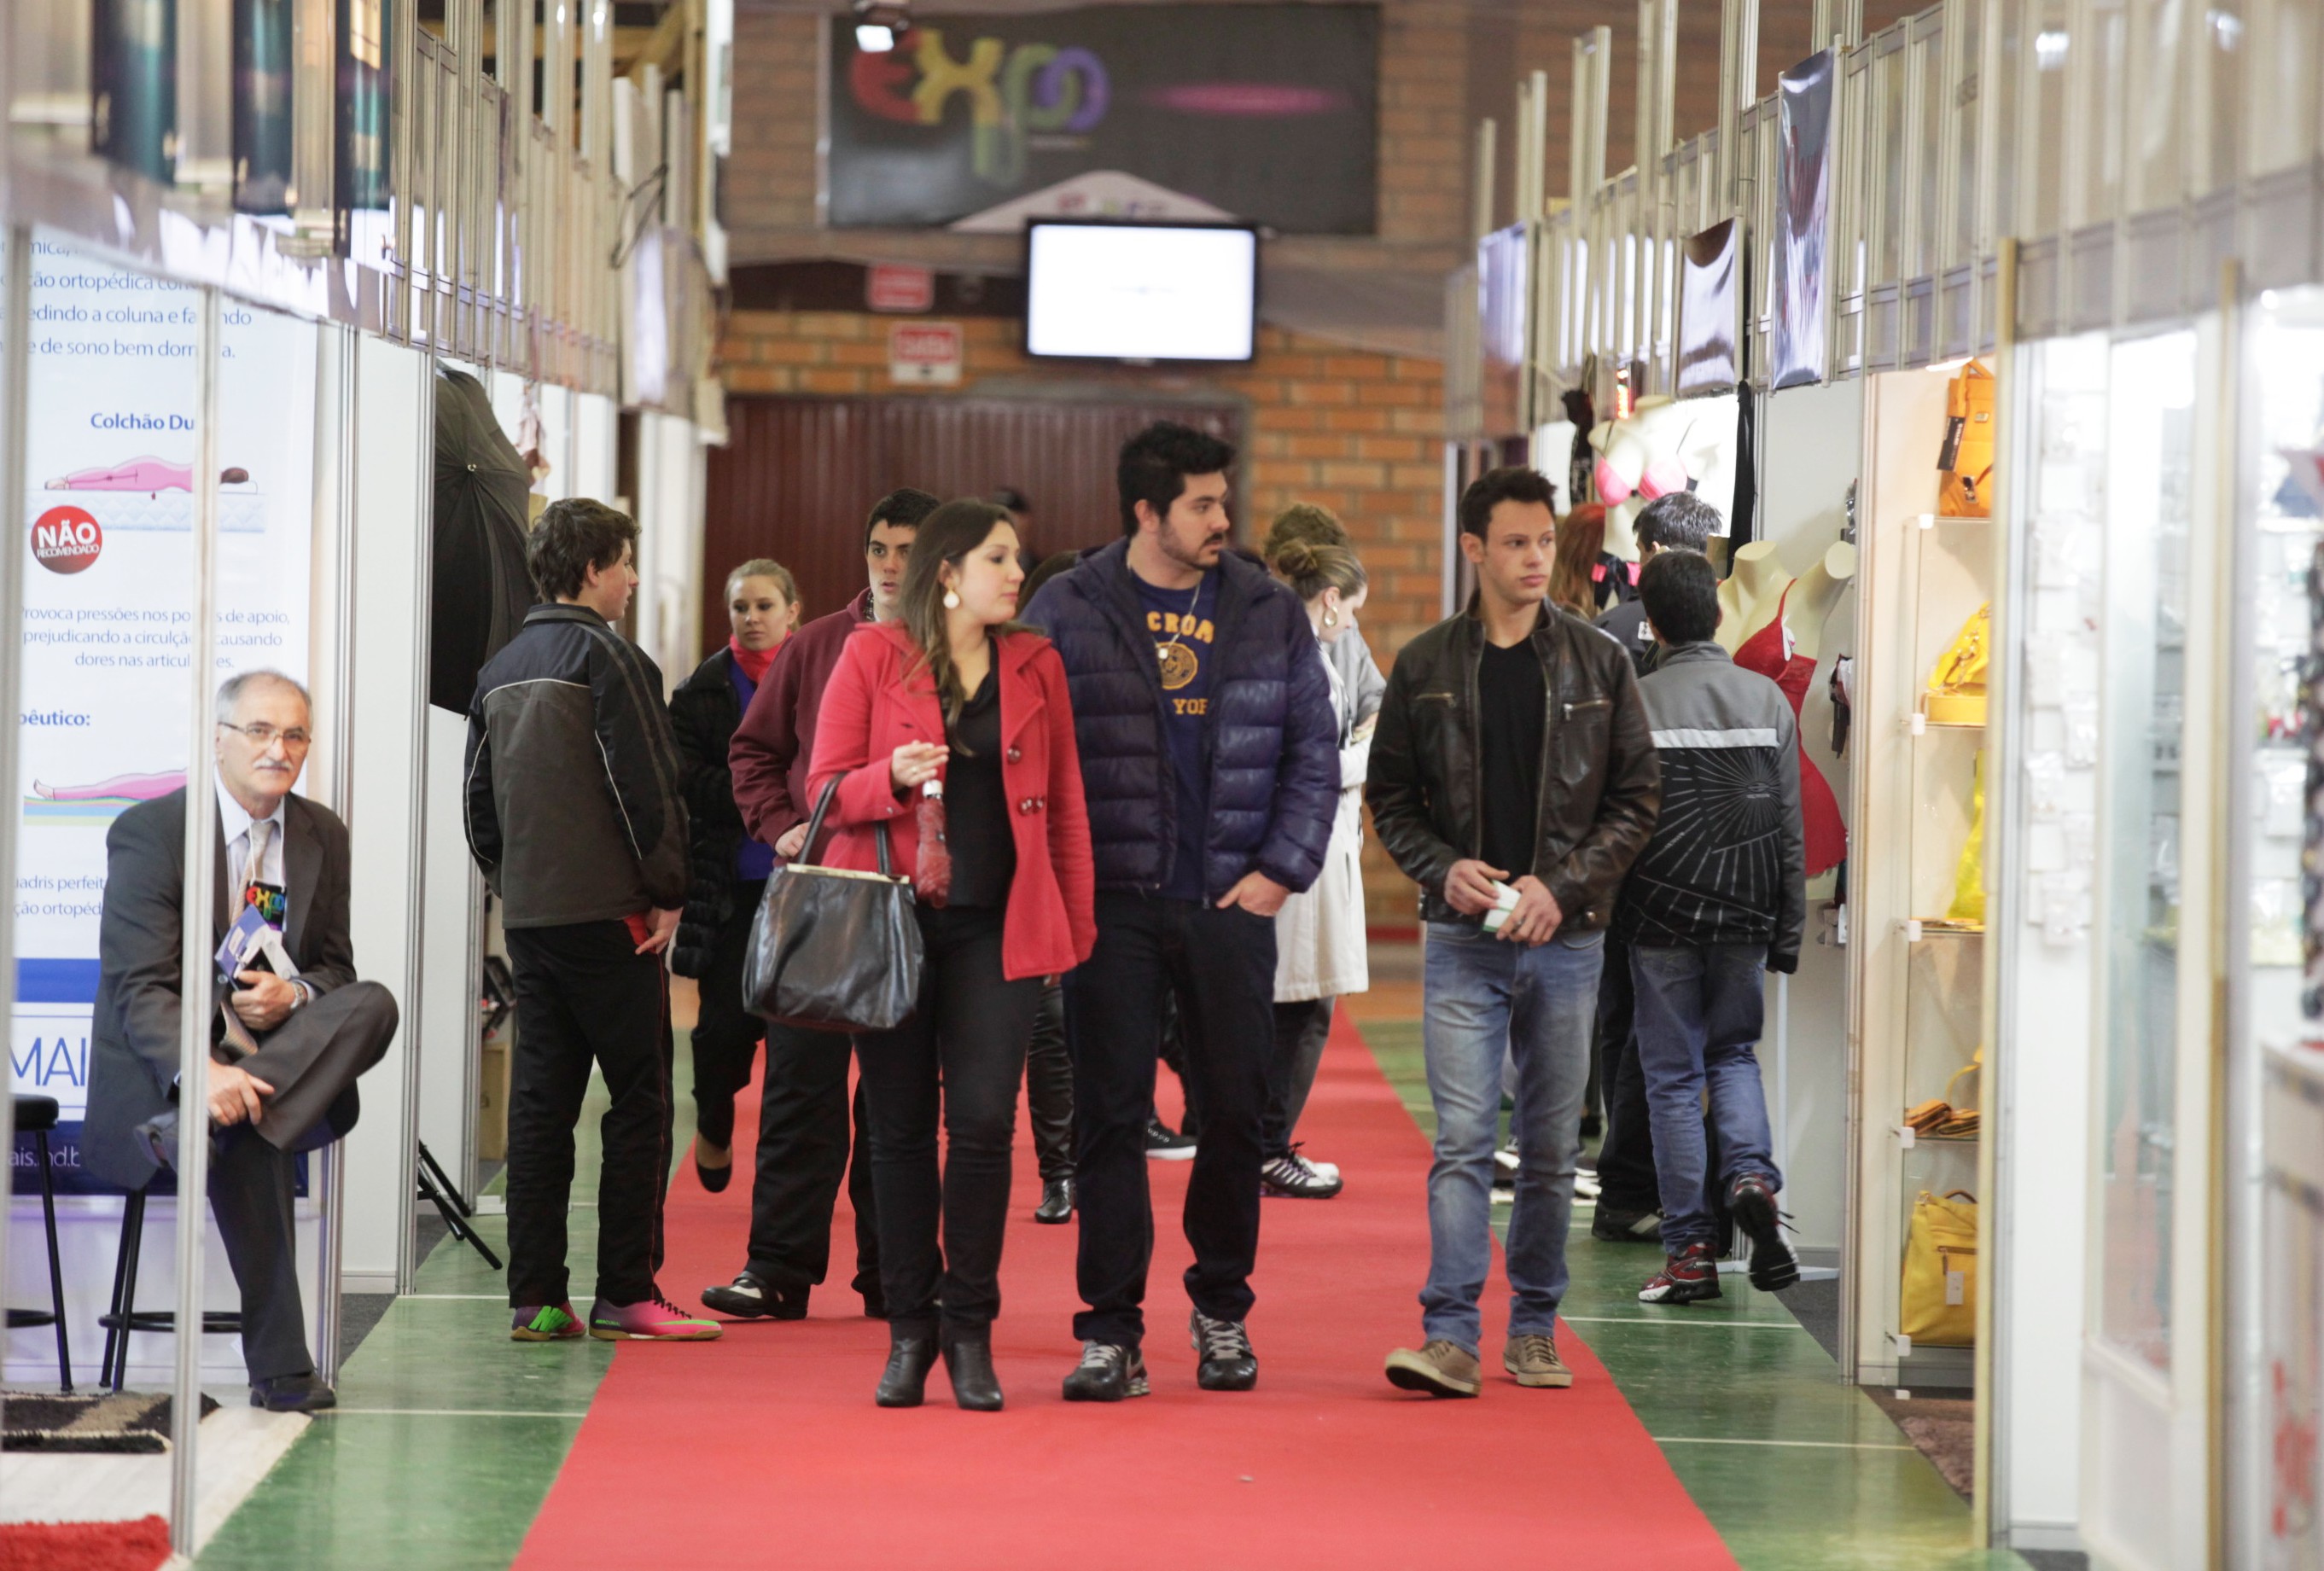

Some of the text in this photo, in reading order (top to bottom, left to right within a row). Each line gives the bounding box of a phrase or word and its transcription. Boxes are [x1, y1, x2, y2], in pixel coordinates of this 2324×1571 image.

[59, 271, 154, 293] ortopédica
[91, 309, 102, 322] a
[106, 305, 164, 323] coluna
[168, 311, 178, 323] e
[183, 306, 252, 325] fando
[40, 336, 62, 354] de
[67, 341, 109, 356] sono
[114, 338, 154, 357] bem
[90, 413, 195, 430] Colchão Du
[37, 520, 96, 548] NÃO
[37, 544, 100, 558] RECOMENDADO
[77, 607, 139, 623] pressões
[142, 610, 168, 622] nos
[225, 608, 245, 623] de
[248, 610, 290, 625] apoio,
[23, 629, 120, 646] prejudicando
[123, 632, 131, 644] a
[135, 630, 191, 649] circulçã
[74, 651, 235, 669] dores nas articules.
[19, 709, 90, 727] pêutico:
[57, 875, 103, 893] perfeit
[13, 900, 102, 919] ção ortopéd
[9, 1037, 86, 1086] MAI
